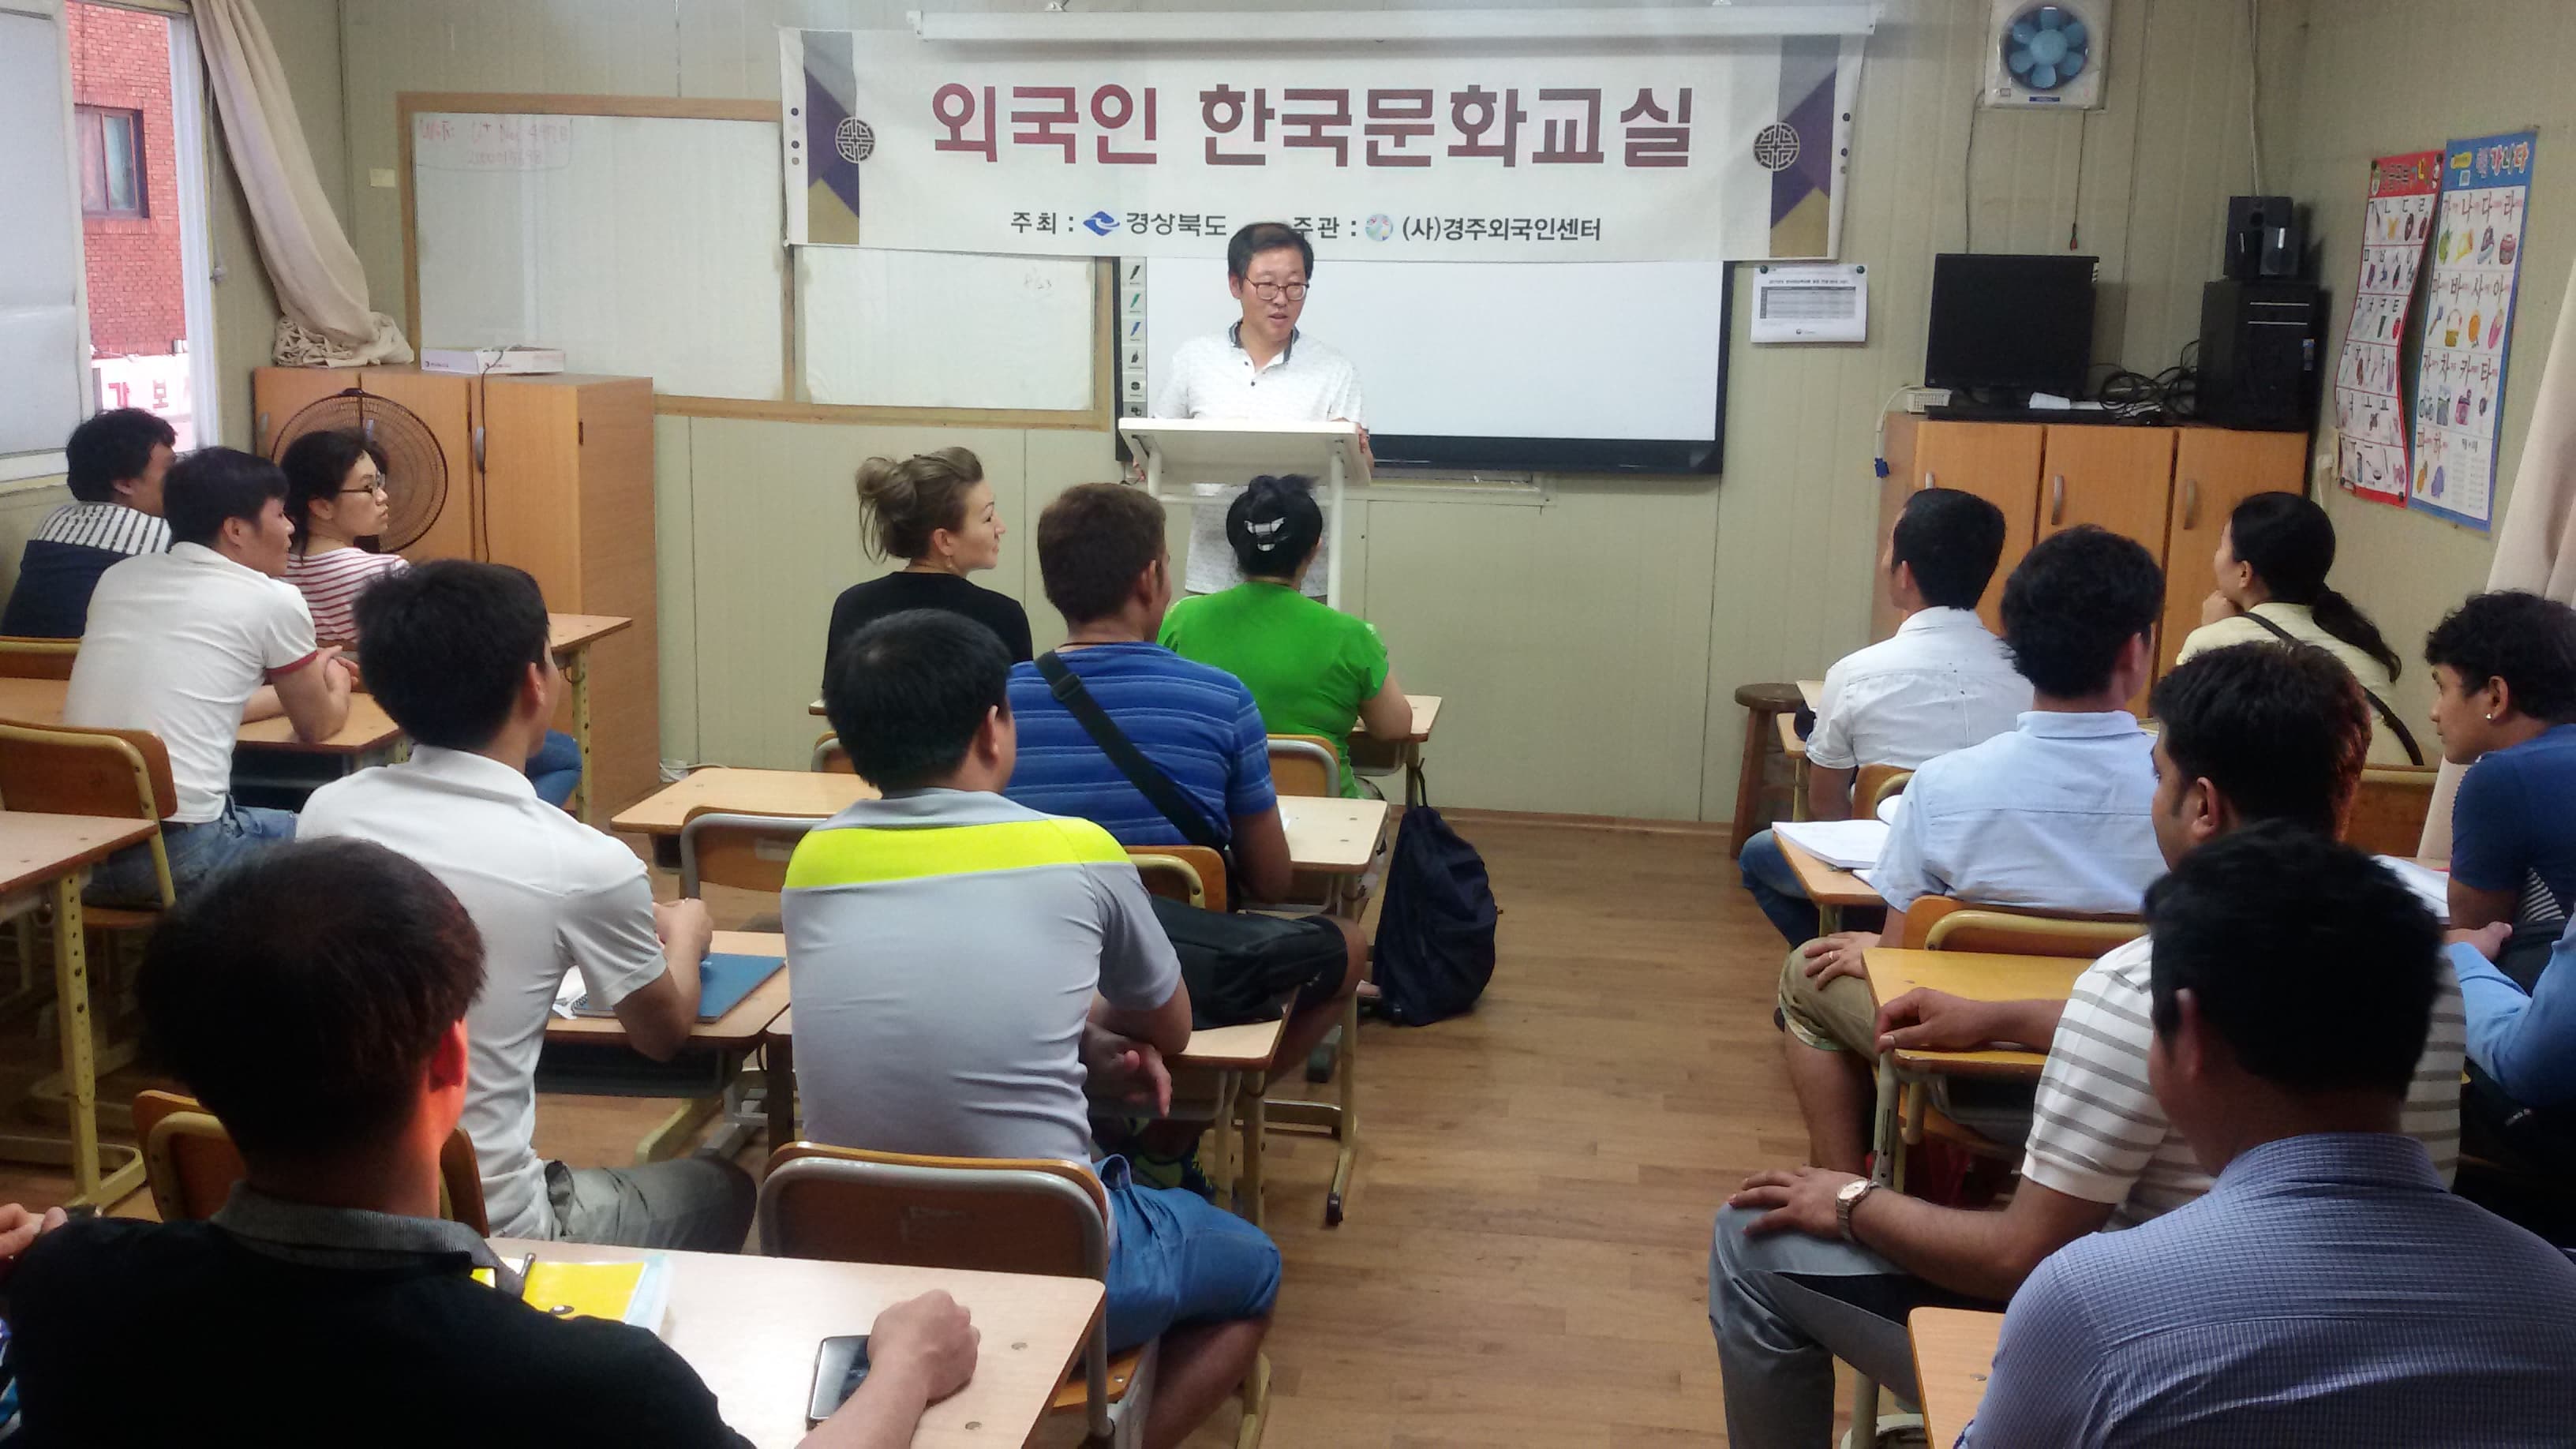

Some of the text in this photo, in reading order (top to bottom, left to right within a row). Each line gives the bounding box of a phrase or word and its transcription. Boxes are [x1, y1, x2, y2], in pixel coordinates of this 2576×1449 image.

[932, 83, 1693, 167] 외국인 한국문화교실
[1011, 212, 1056, 234] 주최
[1126, 212, 1227, 237] 경상북도
[1292, 216, 1340, 238] 주관
[1402, 216, 1601, 241] (사)경주외국인센터
